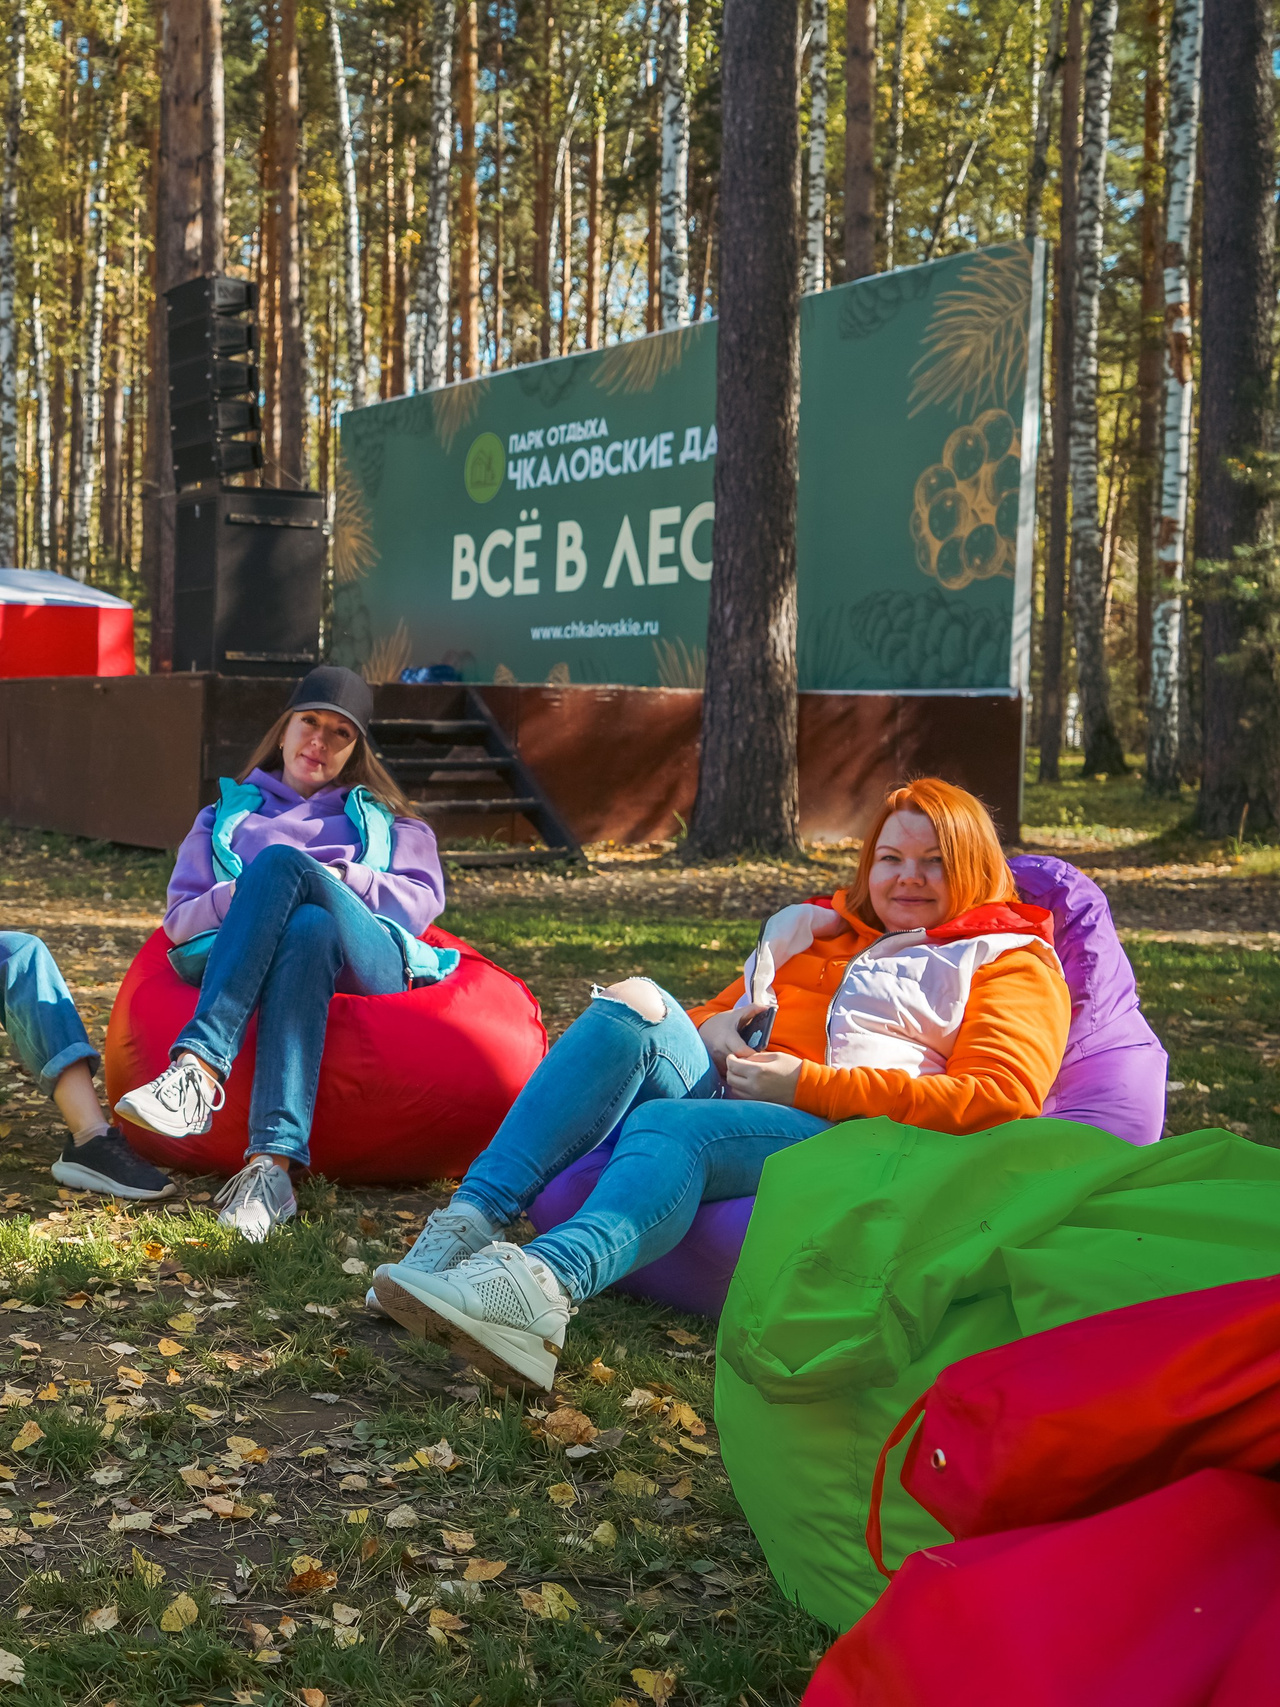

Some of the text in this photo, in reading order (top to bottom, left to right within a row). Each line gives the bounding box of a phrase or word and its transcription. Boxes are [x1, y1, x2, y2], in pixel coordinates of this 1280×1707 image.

[507, 424, 718, 491] ЧКАЛОВСКИЕ ДА
[508, 417, 609, 454] ПАРК ОТДЫХА
[451, 501, 716, 600] ВСЁ В ЛЕС
[530, 617, 660, 641] www.chkalovskie.ru
